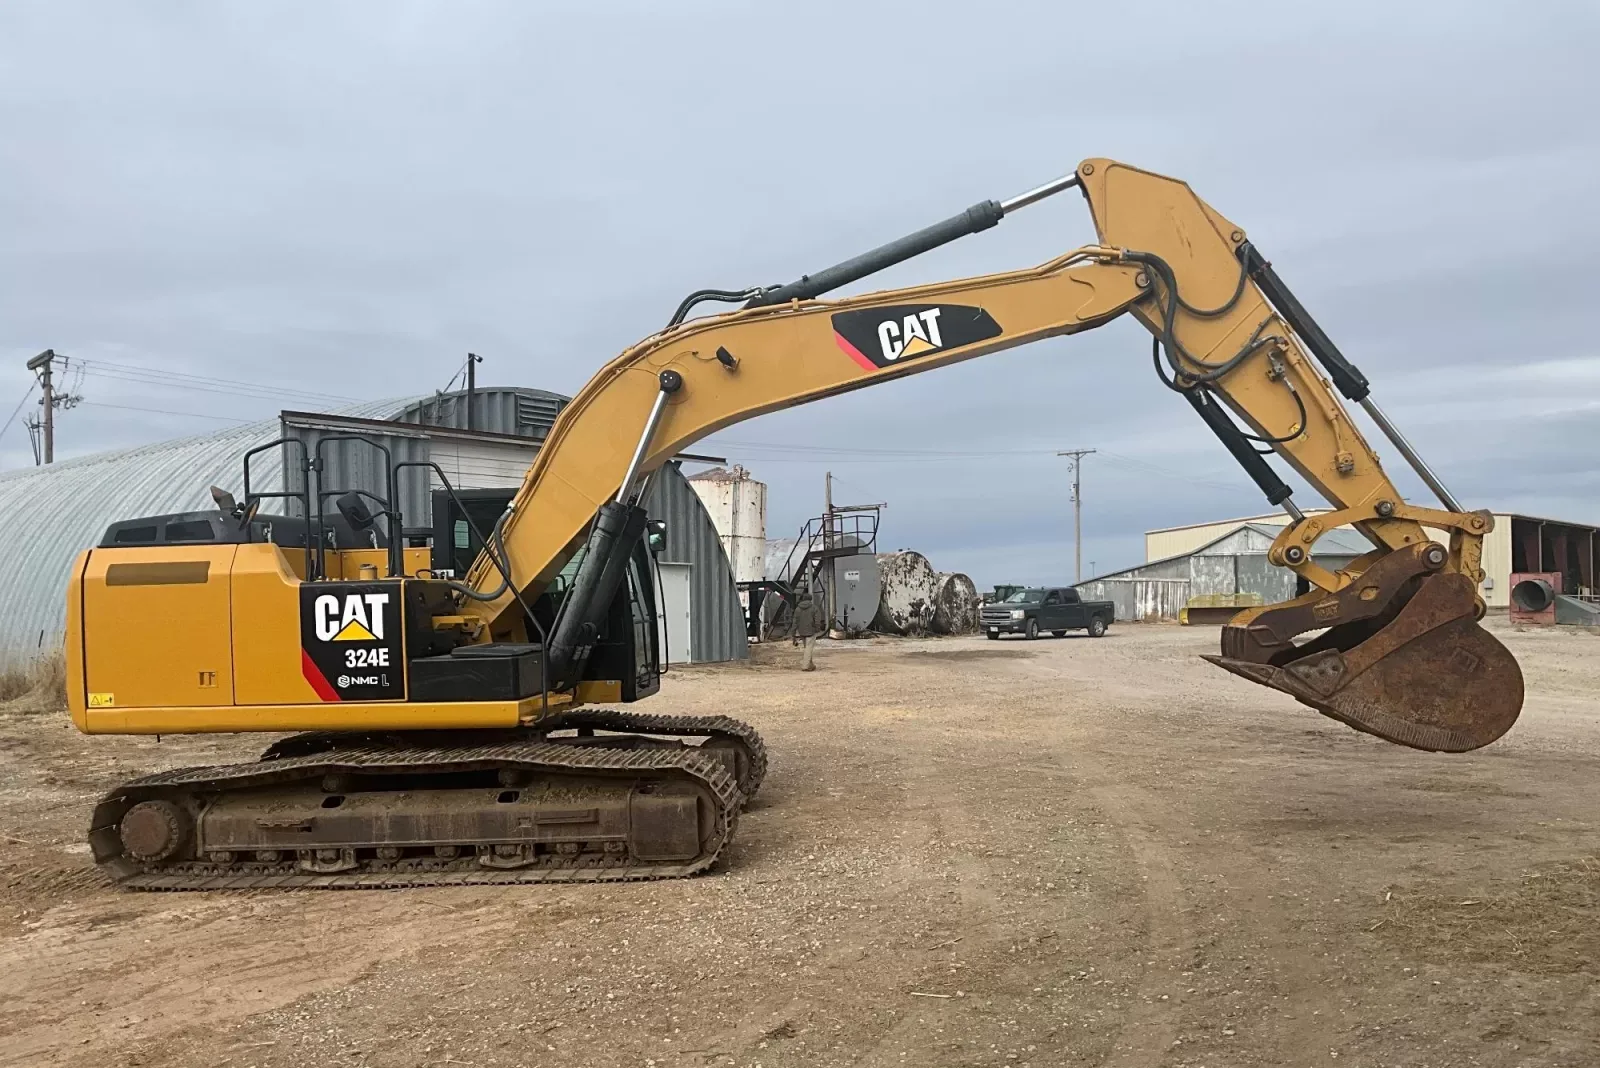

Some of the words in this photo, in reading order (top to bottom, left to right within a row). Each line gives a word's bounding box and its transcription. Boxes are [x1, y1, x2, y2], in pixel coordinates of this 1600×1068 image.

[877, 307, 943, 361] CAT
[314, 593, 390, 642] CAT
[345, 648, 390, 668] 324E
[351, 676, 378, 685] NMC
[382, 674, 389, 686] L
